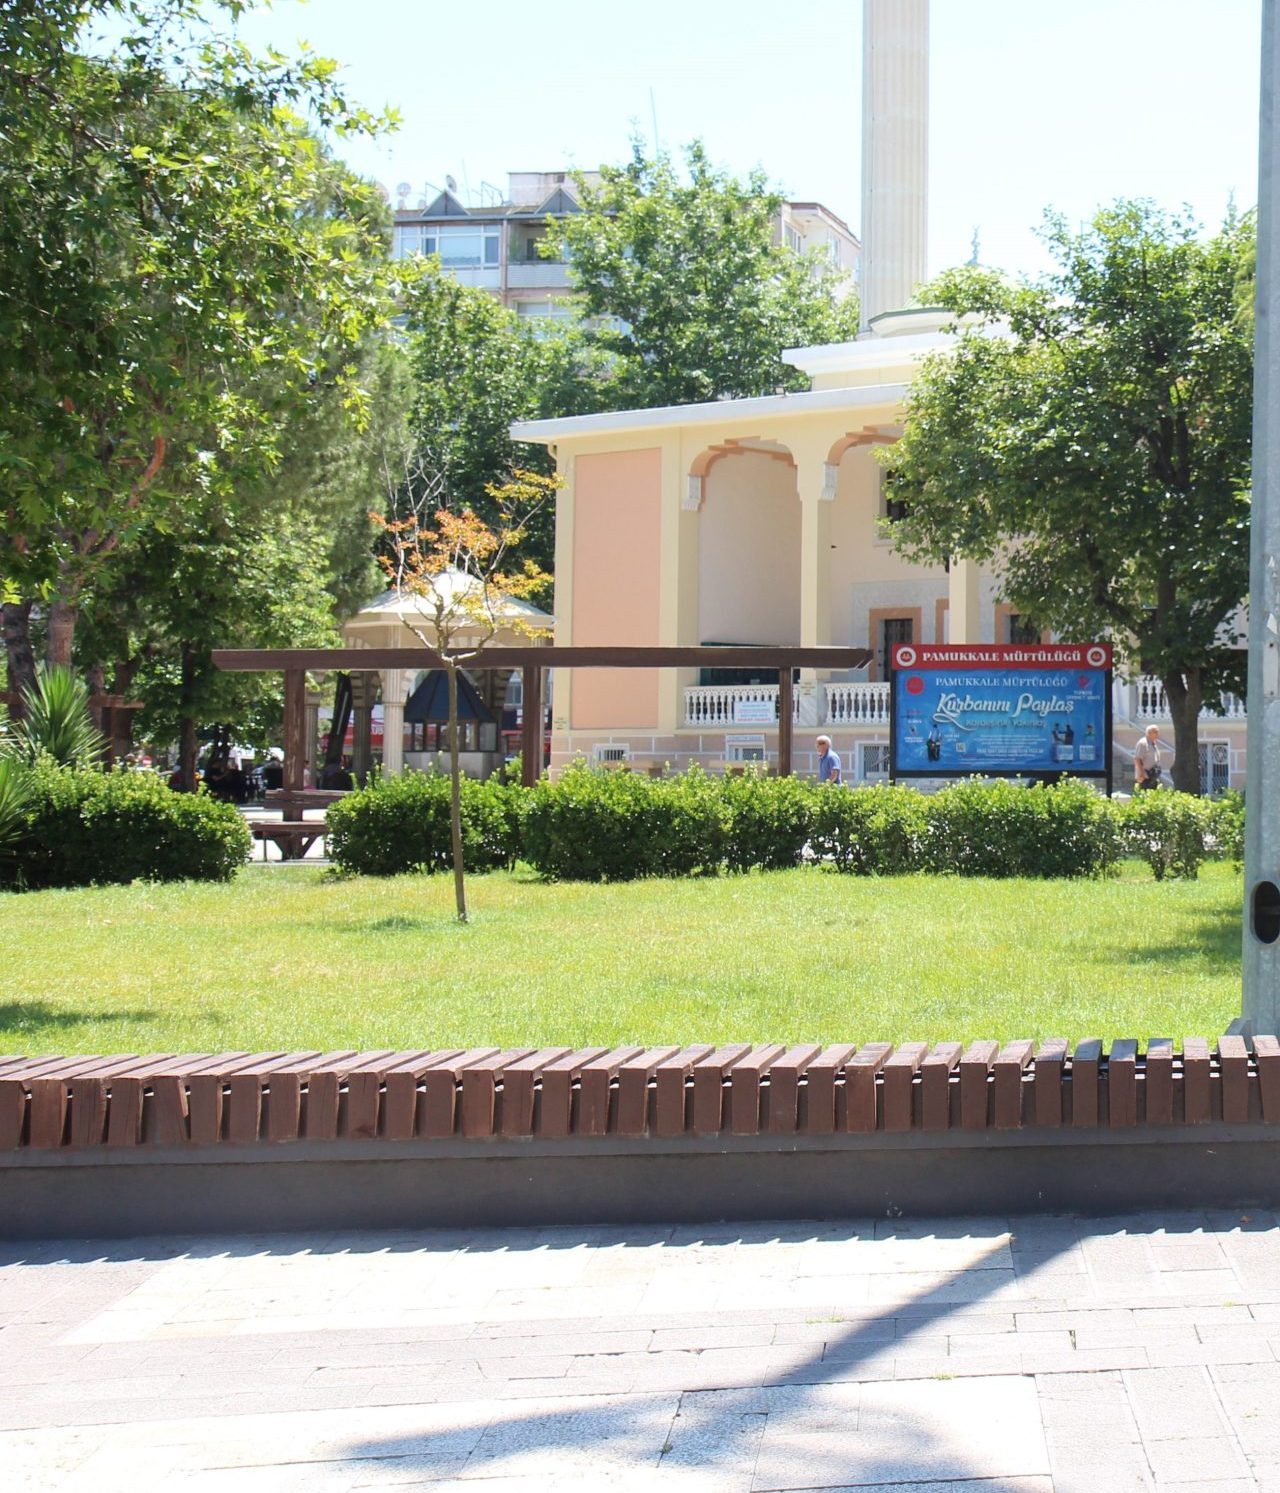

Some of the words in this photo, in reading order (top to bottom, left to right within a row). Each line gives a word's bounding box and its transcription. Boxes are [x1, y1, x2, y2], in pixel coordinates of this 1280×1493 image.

[923, 652, 1000, 662] PAMUKKALE
[1002, 650, 1081, 662] MÜFTÜLÜĞÜ
[936, 677, 1000, 687] PAMUKKALE
[1002, 674, 1068, 687] MÜFTÜLÜĞÜ
[933, 693, 1010, 722] Kurbanını
[1011, 693, 1074, 718] Paylaş
